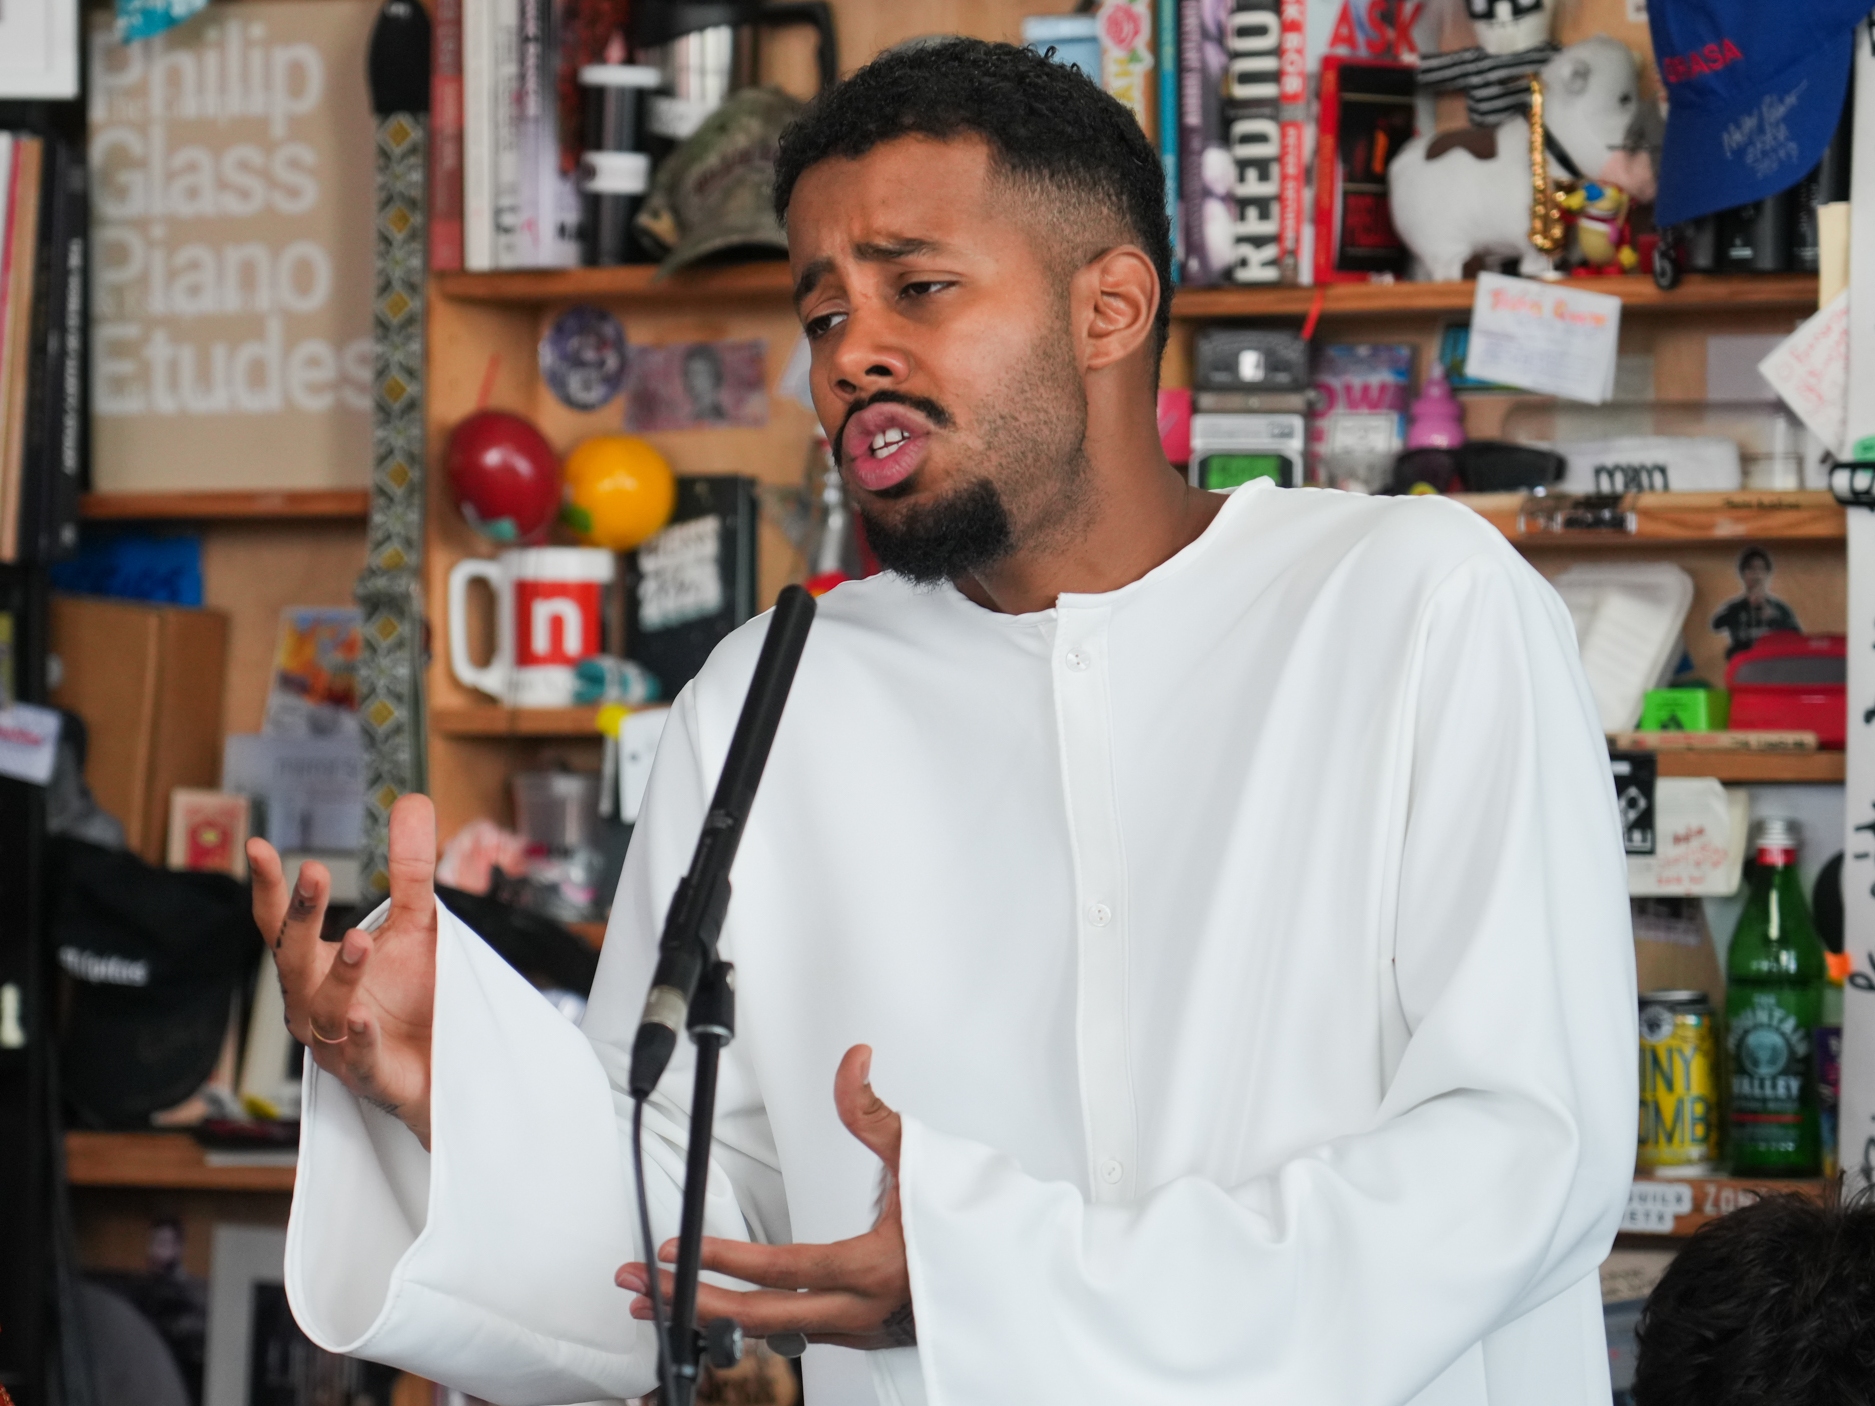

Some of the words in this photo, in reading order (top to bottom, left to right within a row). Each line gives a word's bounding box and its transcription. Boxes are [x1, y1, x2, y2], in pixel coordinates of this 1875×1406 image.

[90, 20, 325, 138] Philip
[90, 125, 320, 217] Glass
[1231, 118, 1280, 283] REED
[92, 225, 333, 315] Piano
[94, 312, 375, 416] Etudes
[531, 597, 584, 656] n
